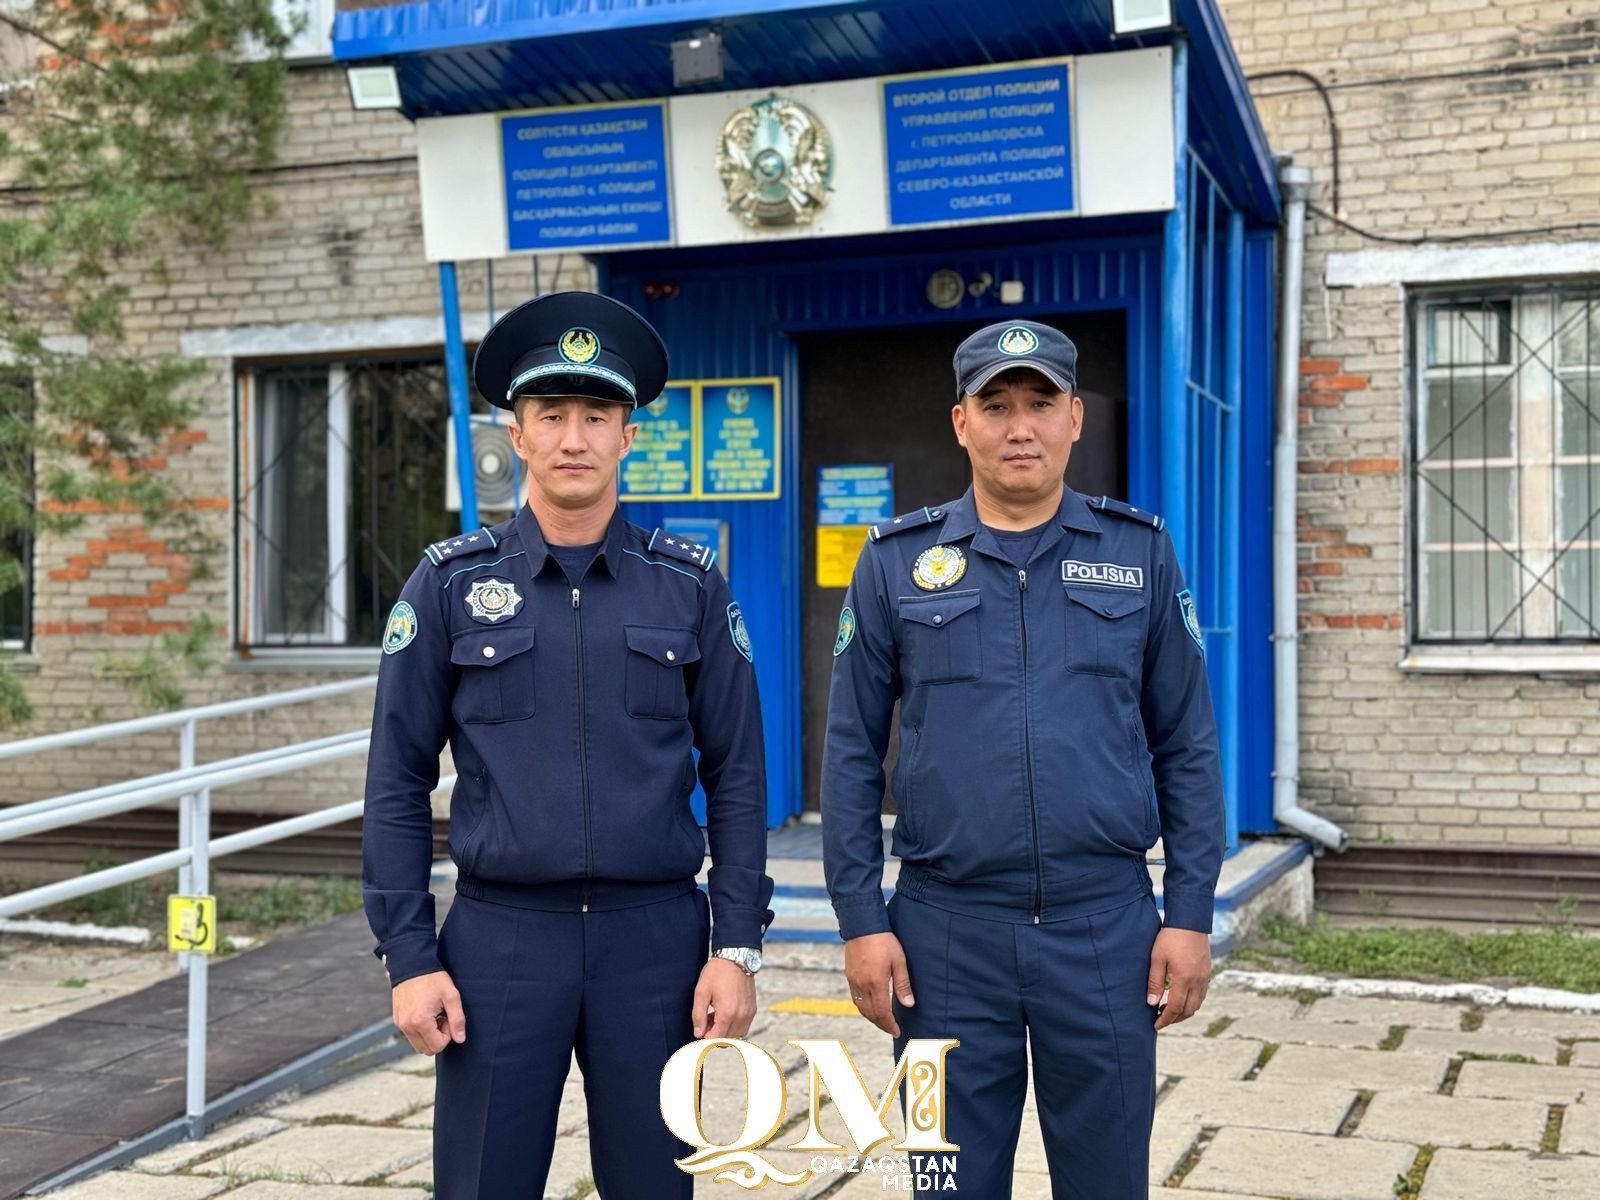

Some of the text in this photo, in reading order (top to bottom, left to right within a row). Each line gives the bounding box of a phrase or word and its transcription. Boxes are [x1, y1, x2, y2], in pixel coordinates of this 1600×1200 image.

[892, 78, 1060, 108] ВТОРОЙ ОТДЕЛ ПОЛИЦИИ
[901, 102, 1055, 127] УПРАВЛЕНИЯ ПОЛИЦИИ
[921, 125, 1044, 147] ПЕТРОПАВЛОВСКА
[895, 145, 1066, 173] ДЕПАРТАМЕНТА ПОЛИЦИИ
[897, 167, 1064, 193] СЕВЕРО-КАЗАХСТАНСКОЙ
[950, 193, 1012, 209] ОБЛАСТИ
[1067, 563, 1137, 585] POLISIA
